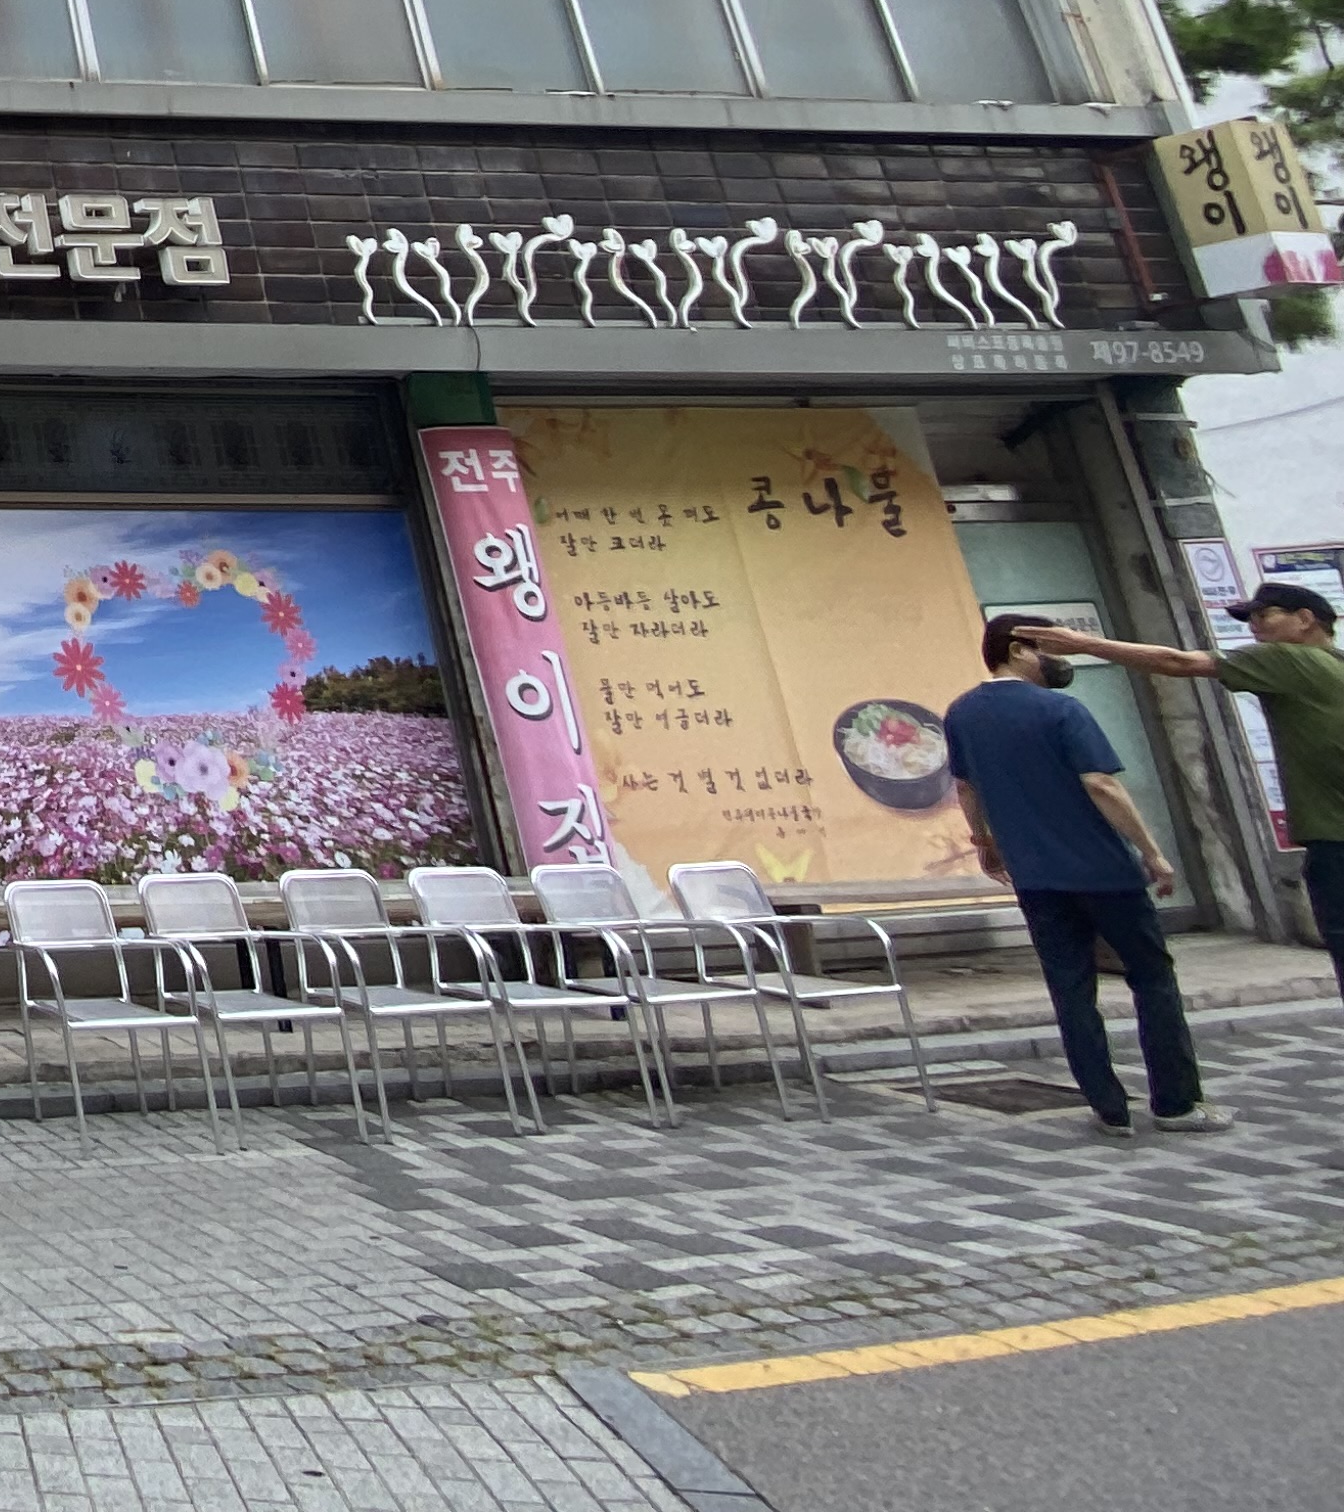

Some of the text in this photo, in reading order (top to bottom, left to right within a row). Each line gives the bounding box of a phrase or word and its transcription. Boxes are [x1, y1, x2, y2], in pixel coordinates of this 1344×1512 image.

[1179, 129, 1247, 235] 왱이
[1250, 126, 1309, 230] 왱이
[438, 448, 519, 493] 전주
[747, 465, 907, 538] 콩나물
[573, 588, 721, 614] 아등바등 살아도
[580, 618, 709, 645] 잘만 자라더라
